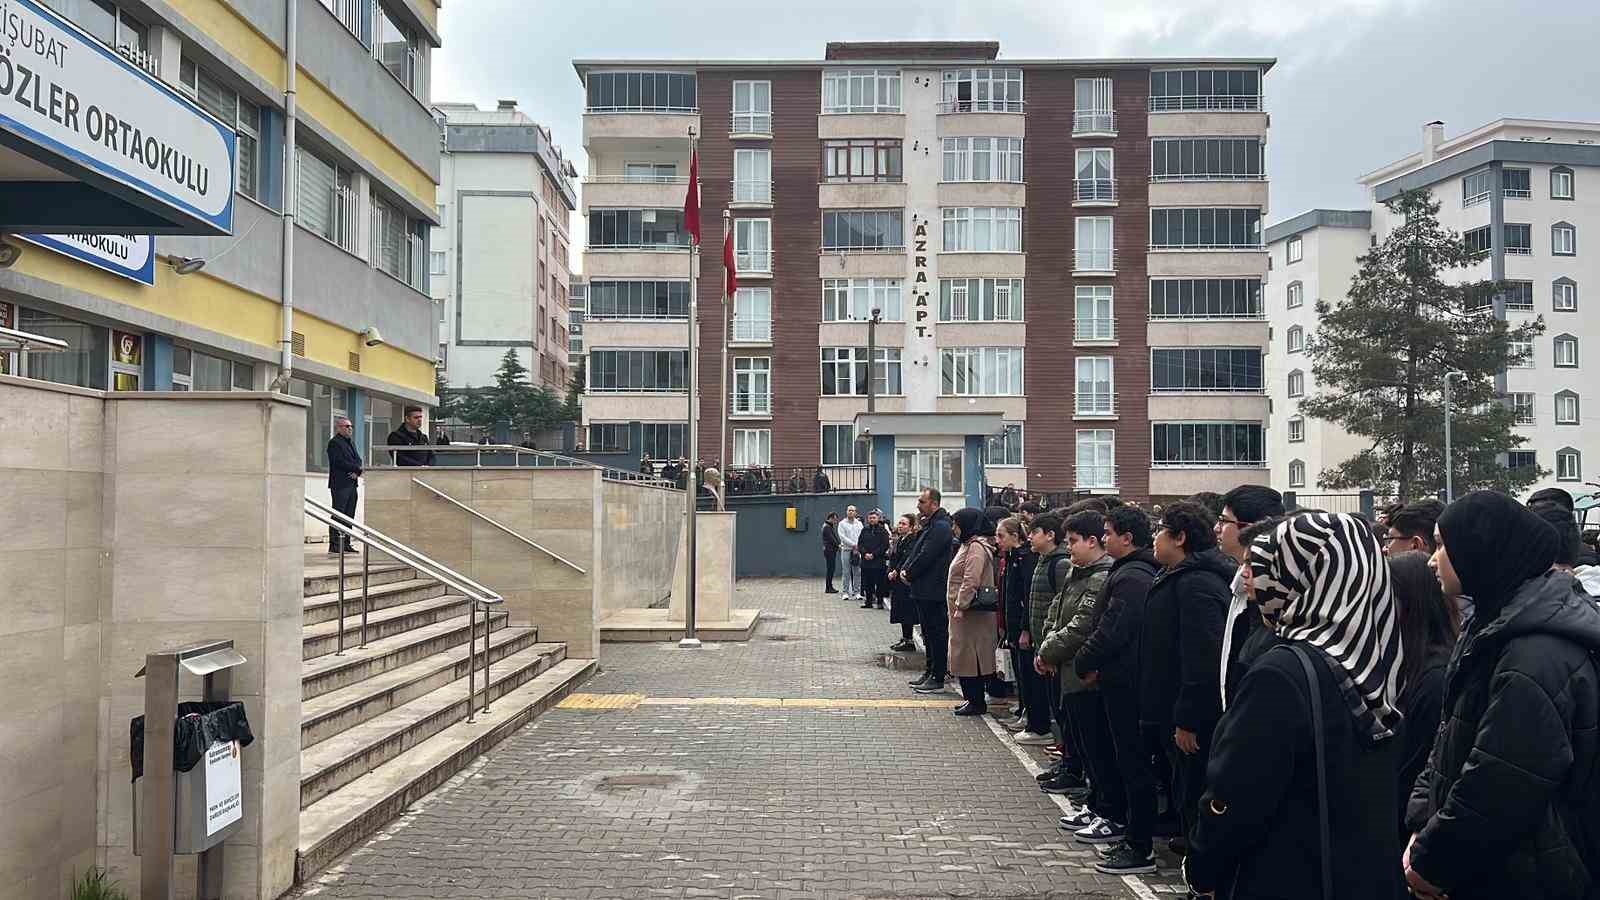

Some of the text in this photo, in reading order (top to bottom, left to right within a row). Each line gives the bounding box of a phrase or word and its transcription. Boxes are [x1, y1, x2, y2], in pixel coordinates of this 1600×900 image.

[0, 3, 68, 69] İŞUBAT
[86, 105, 209, 197] ORTAOKULU
[915, 224, 927, 283] AZRA
